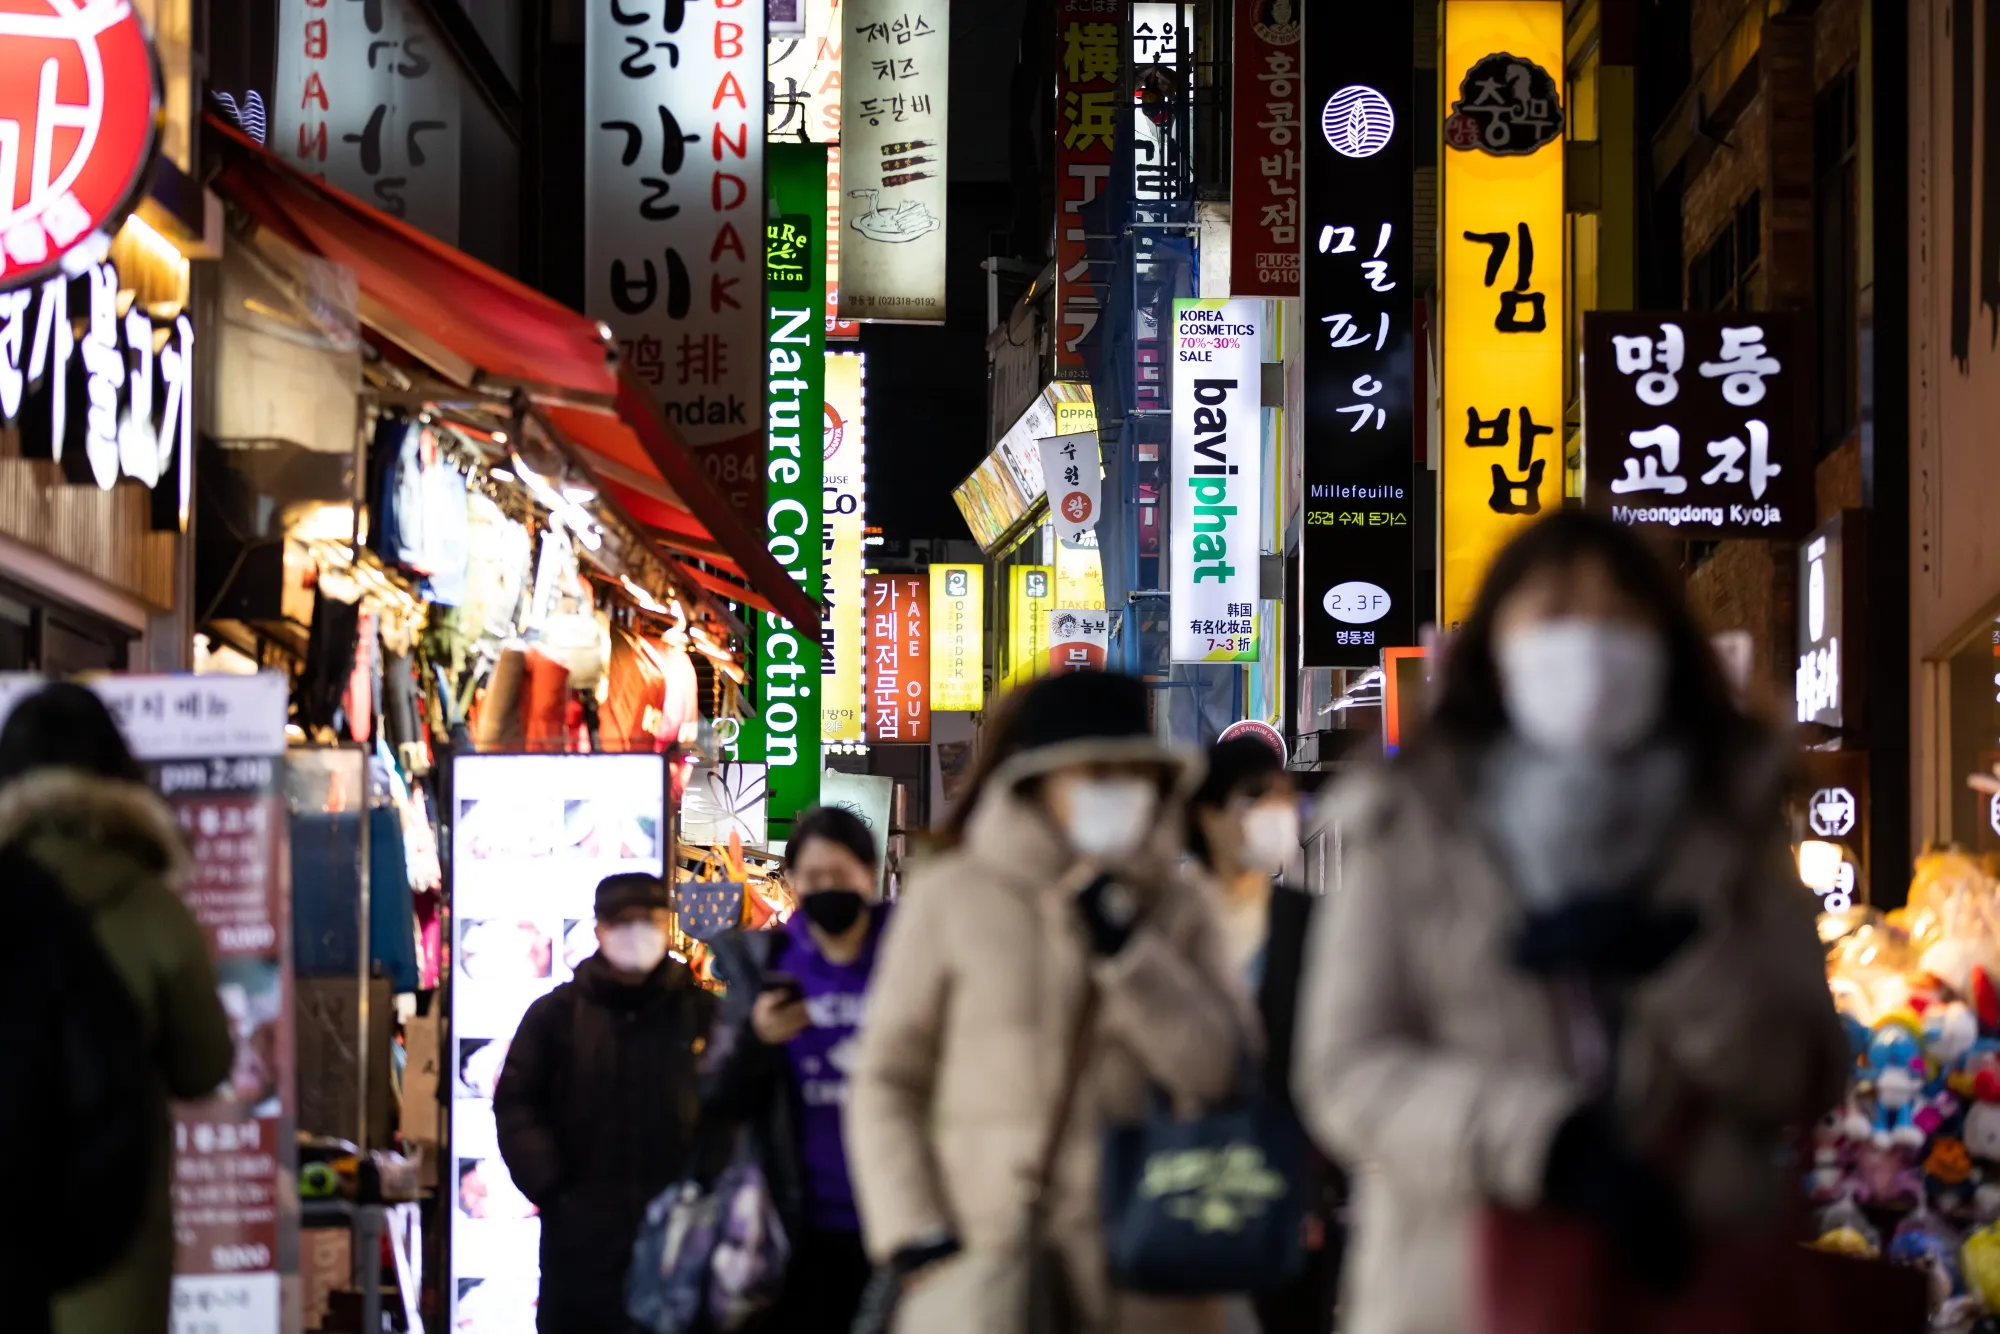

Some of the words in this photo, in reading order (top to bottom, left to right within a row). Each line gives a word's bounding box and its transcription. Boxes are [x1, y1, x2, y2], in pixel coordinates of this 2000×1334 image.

[856, 14, 936, 44] 제임스
[871, 58, 919, 82] 치즈
[860, 93, 932, 127] 등갈비
[710, 0, 748, 315] BANDAK
[1256, 51, 1300, 245] 홍콩반점
[1258, 254, 1300, 269] PLUS+
[1259, 269, 1300, 284] 0410
[878, 296, 936, 307] (02)318-0192
[1180, 311, 1225, 322] KOREA
[1180, 324, 1255, 336] COSMETICS
[1319, 222, 1397, 433] 밀피유
[1180, 337, 1241, 349] 70%~30%
[1180, 351, 1213, 362] SALE
[1611, 322, 1782, 406] 명동
[1463, 221, 1554, 515] 김밥
[768, 306, 812, 485] Nature
[1611, 419, 1782, 500] 교자
[1188, 378, 1239, 584] baviphat
[1311, 484, 1404, 499] Millefeuille
[1308, 511, 1334, 526] 25겹
[1338, 511, 1364, 526] 수제
[1369, 511, 1407, 526] 돈가스
[1612, 504, 1724, 526] Myeongdong
[1730, 504, 1782, 526] Kyoja
[1060, 600, 1090, 610] TAKE
[1227, 603, 1253, 618] 韩国
[907, 581, 921, 657] TAKE
[1080, 618, 1107, 635] 놀부
[1190, 620, 1253, 635] 有名化妆品
[955, 600, 964, 679] OPPADAK
[1336, 630, 1375, 645] 명동점
[873, 579, 900, 739] 카레전문점
[906, 680, 922, 737] OUT
[824, 721, 843, 733] 2F
[1240, 725, 1268, 737] BANJUM
